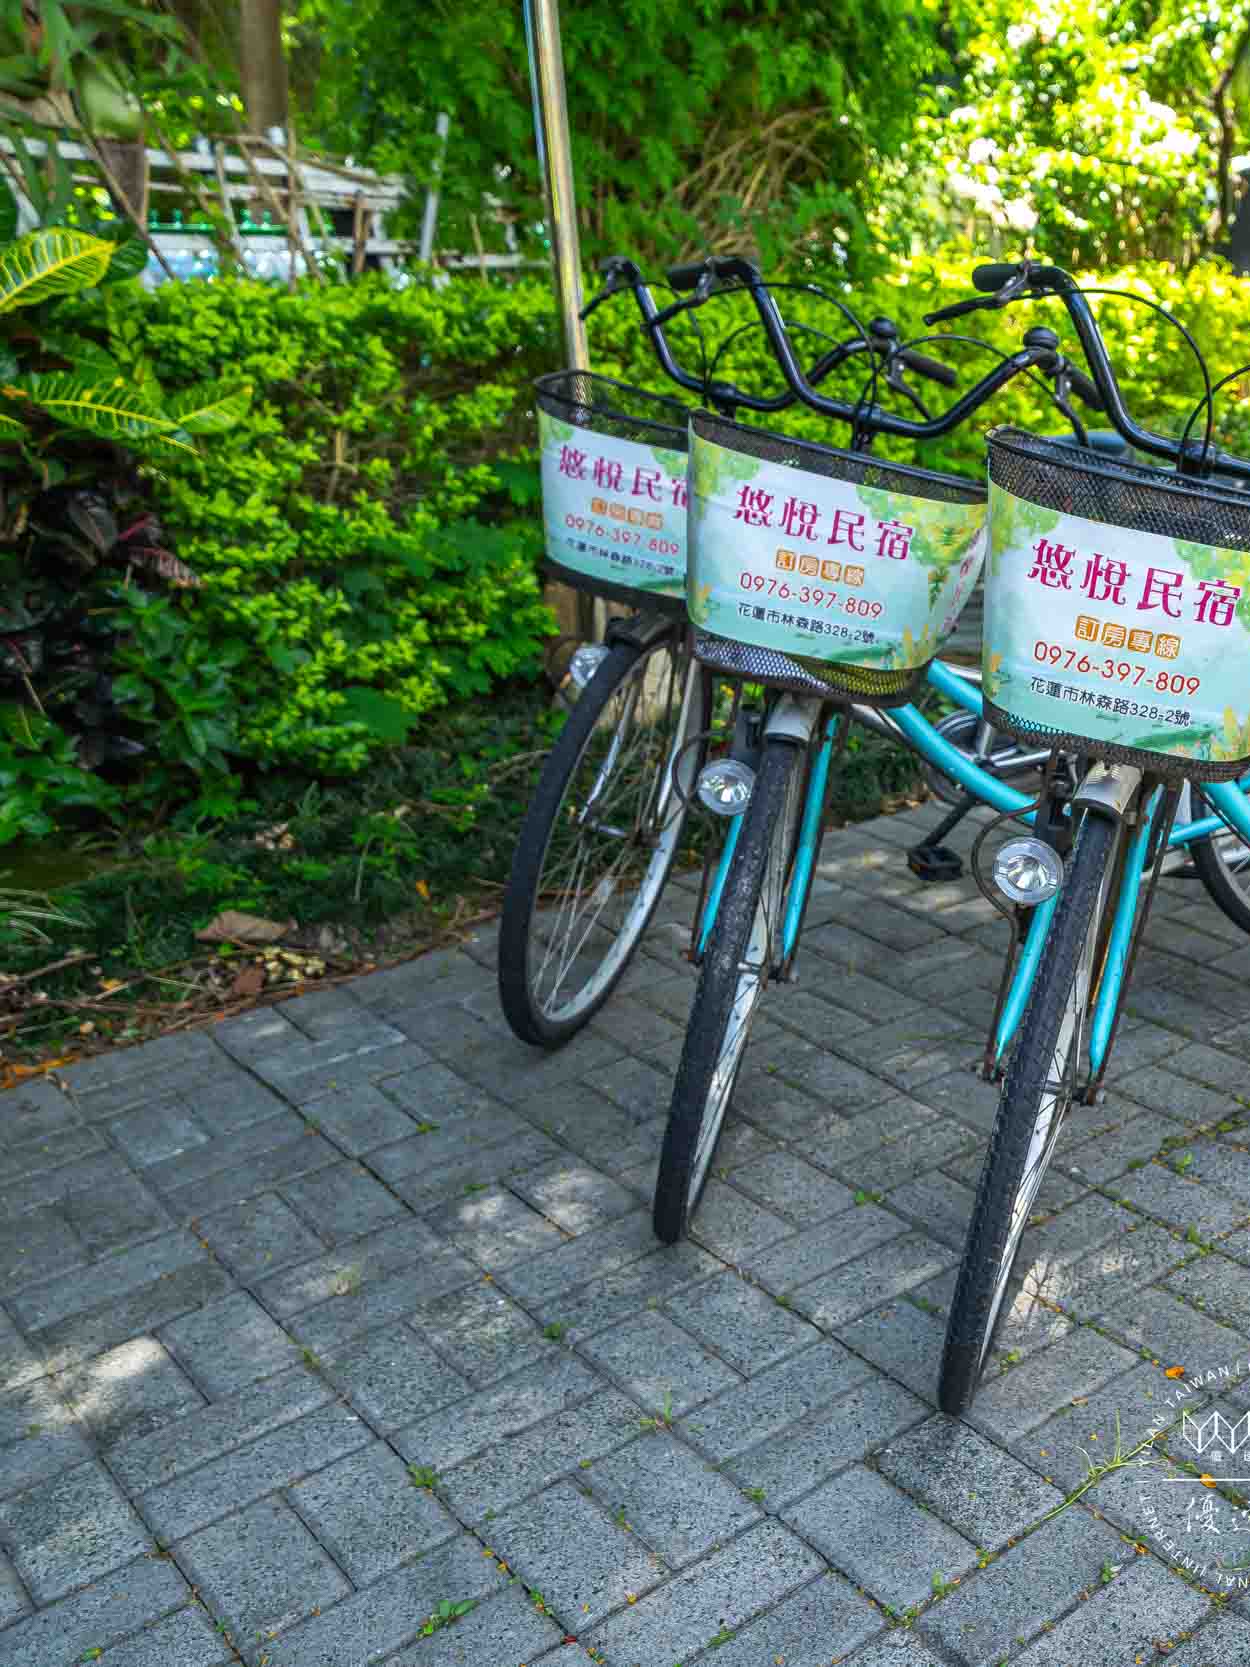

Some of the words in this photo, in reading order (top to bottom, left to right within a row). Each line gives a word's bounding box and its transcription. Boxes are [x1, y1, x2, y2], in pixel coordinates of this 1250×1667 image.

[739, 572, 883, 620] 0976-397-809
[1026, 538, 1242, 627] 悠悅民宿
[1074, 615, 1182, 660] 訂房專線
[1033, 641, 1201, 696] 0976-397-809
[1030, 676, 1191, 728] 花蓮市林森路328-2號
